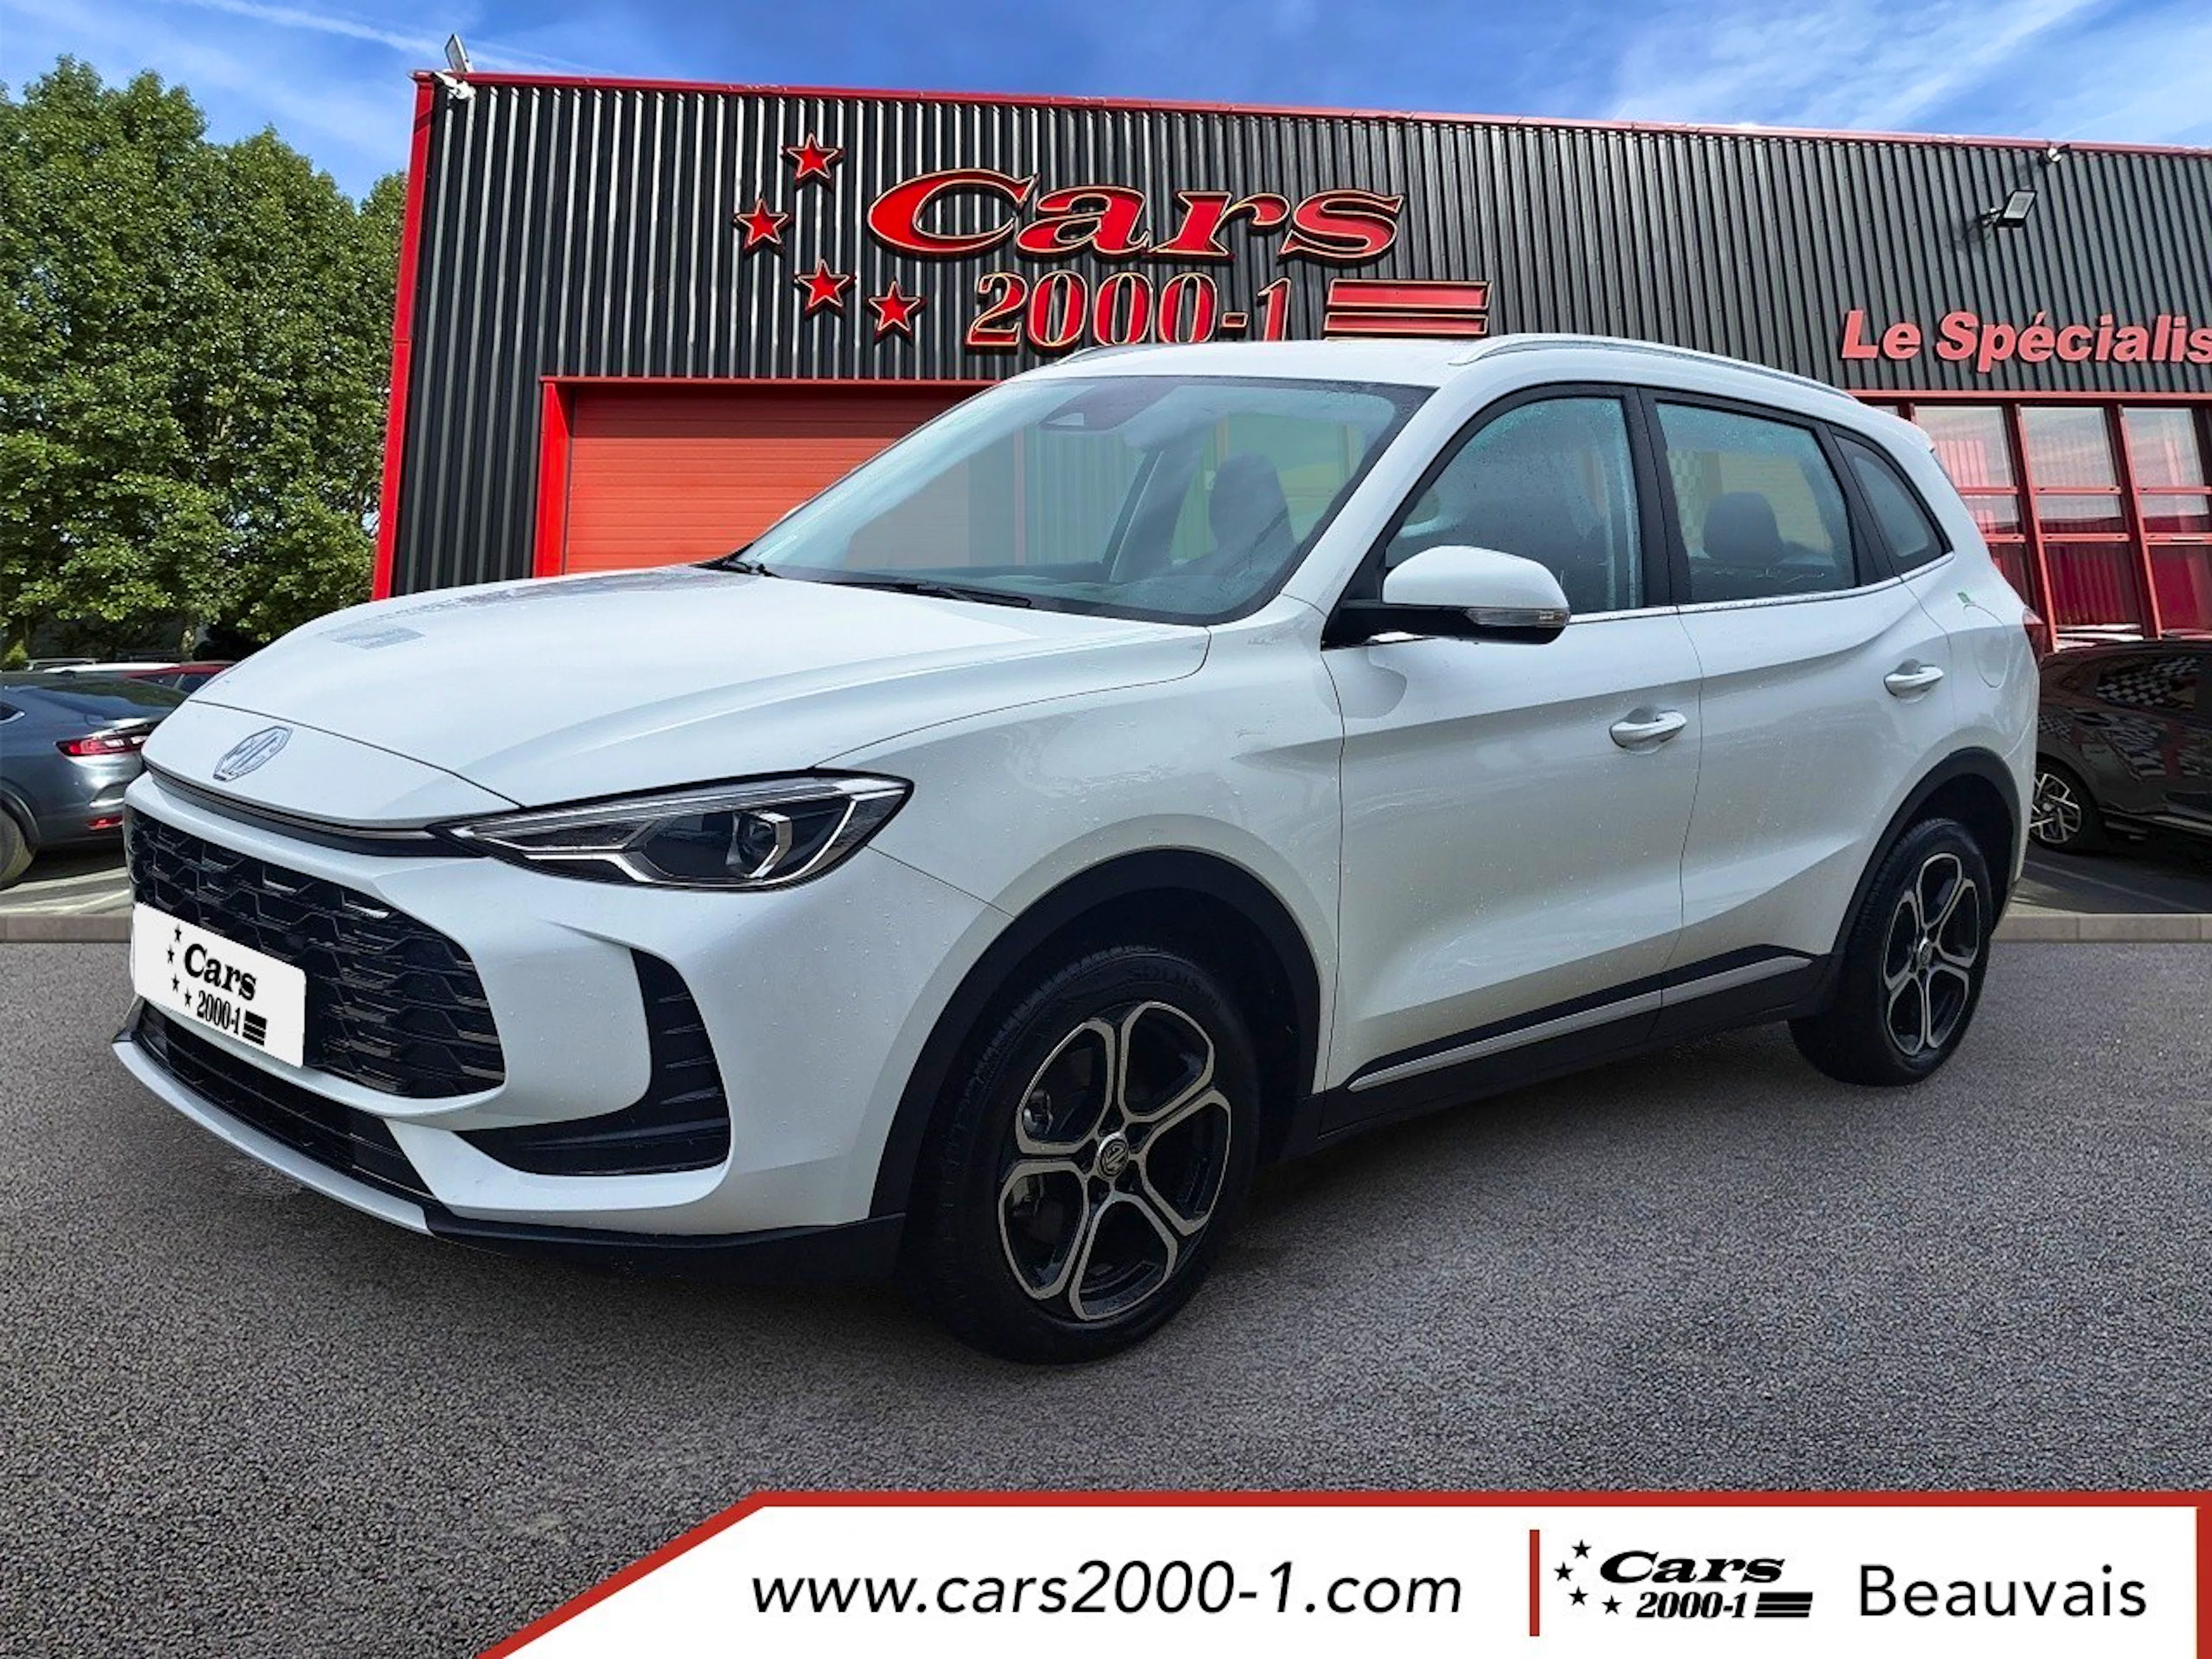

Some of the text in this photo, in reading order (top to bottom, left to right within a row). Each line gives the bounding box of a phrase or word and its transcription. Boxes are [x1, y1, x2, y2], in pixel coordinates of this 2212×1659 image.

[868, 168, 1404, 260] Cars
[966, 270, 1291, 347] 2000-1
[1841, 309, 2212, 373] Le Spécialis
[184, 943, 258, 1001] Cars
[196, 990, 241, 1035] 2000-1
